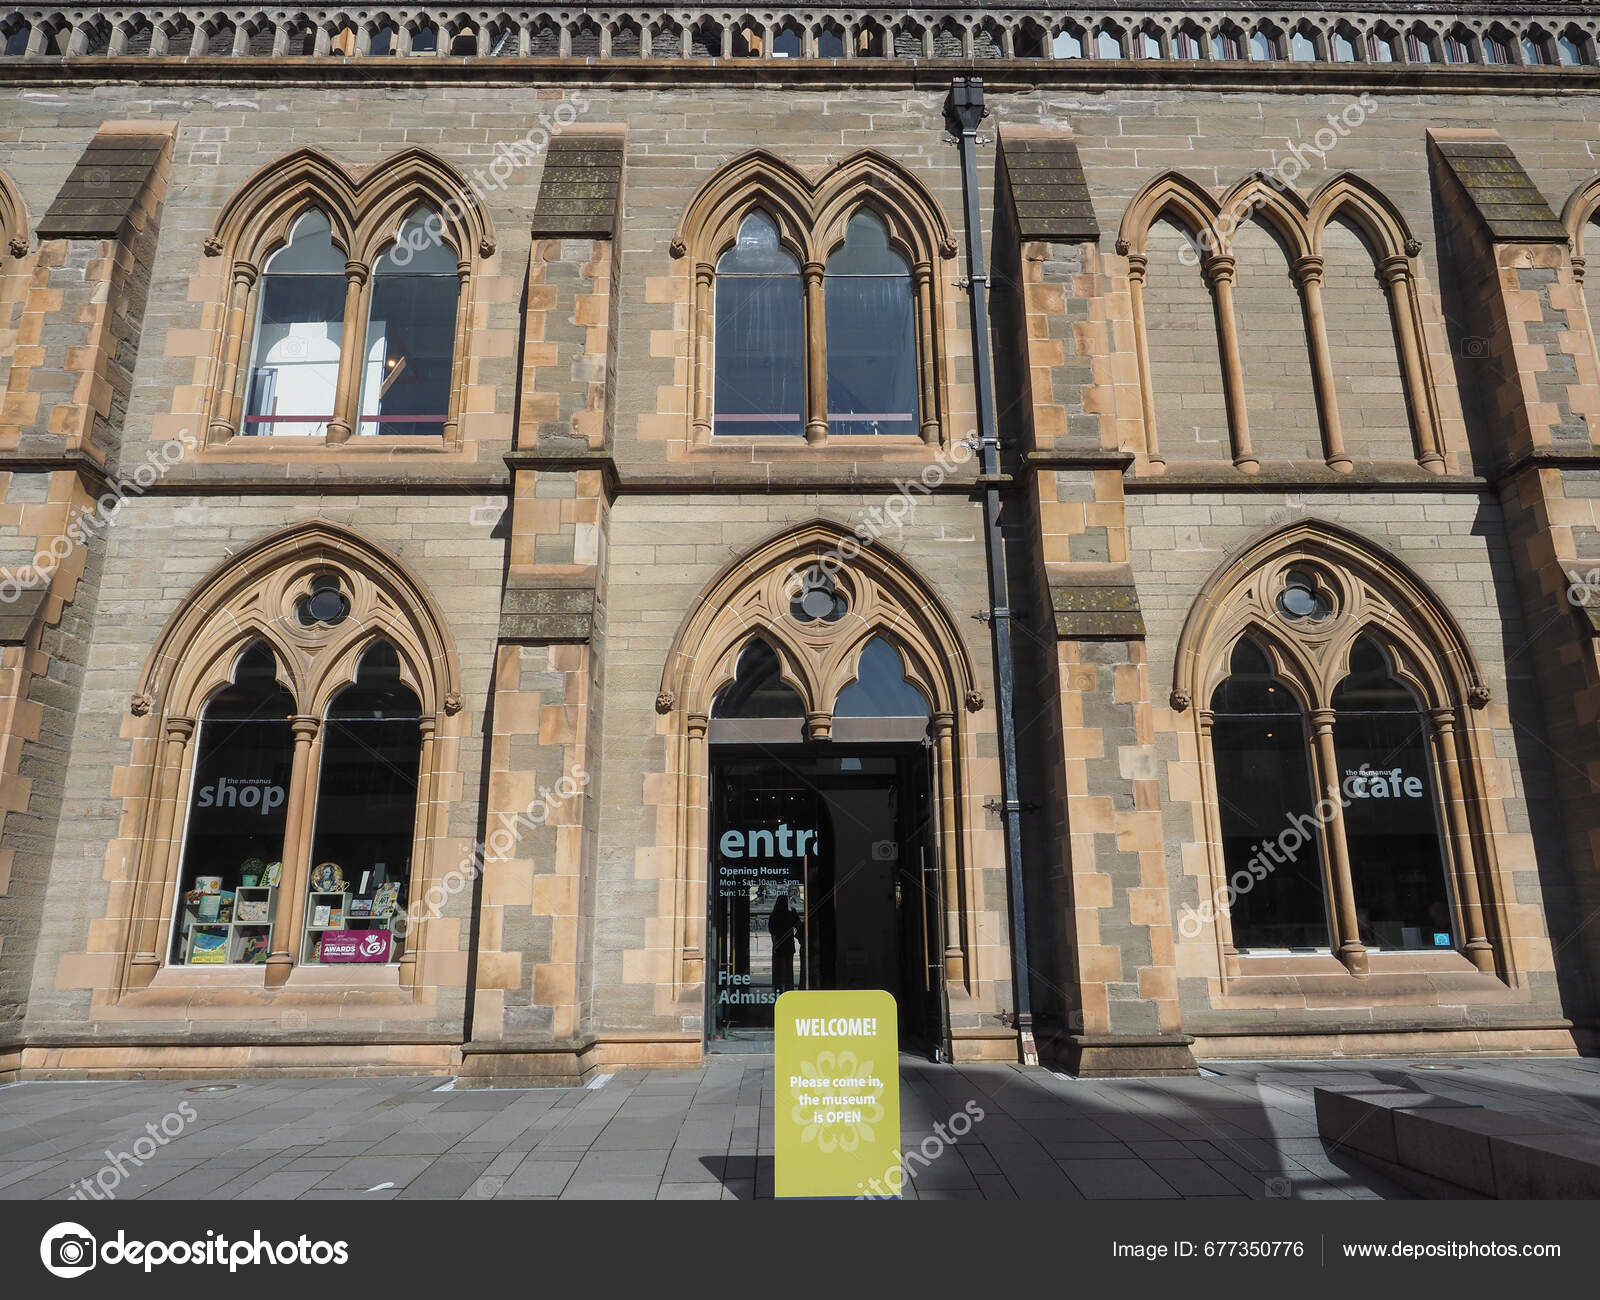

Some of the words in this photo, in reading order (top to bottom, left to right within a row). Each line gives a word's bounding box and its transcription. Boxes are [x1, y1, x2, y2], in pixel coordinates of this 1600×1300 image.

[1345, 768, 1358, 776] the
[1352, 768, 1423, 798] cafe
[198, 777, 285, 815] shop
[719, 866, 758, 877] Opening
[760, 866, 790, 875] Hours:
[783, 879, 800, 887] 5pm
[719, 889, 736, 897] Sun:
[324, 945, 356, 953] AWARDS
[718, 970, 750, 985] Free
[795, 1018, 877, 1036] WELCOME!
[789, 1075, 830, 1088] Please
[832, 1077, 866, 1088] come
[868, 1075, 884, 1089] in,
[799, 1094, 820, 1106] the
[822, 1094, 876, 1106] museum
[813, 1111, 824, 1124] is
[826, 1111, 862, 1123] OPEN
